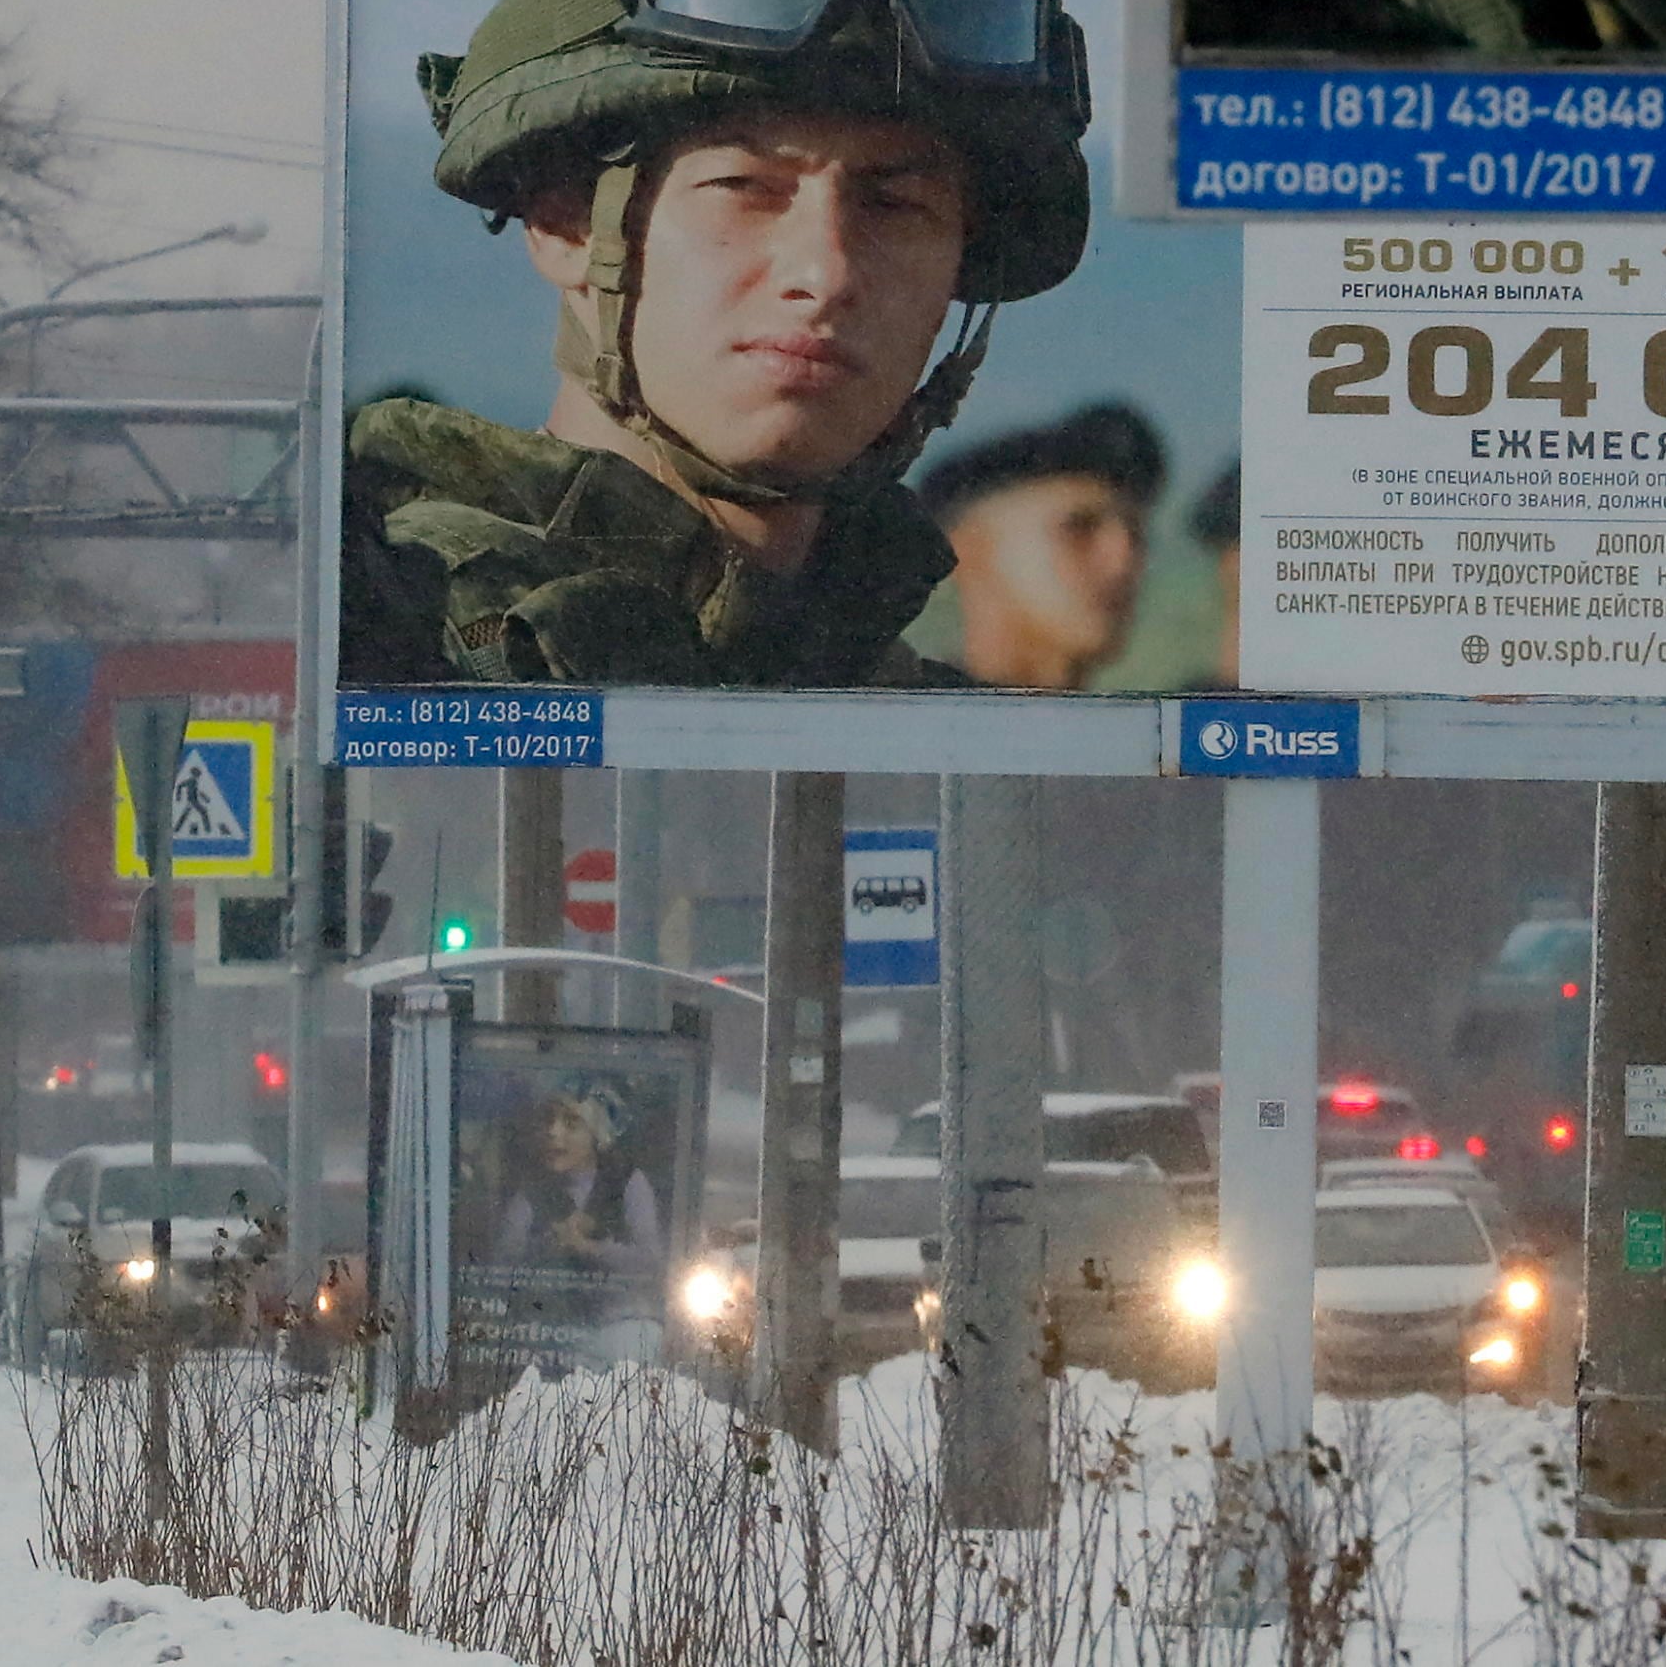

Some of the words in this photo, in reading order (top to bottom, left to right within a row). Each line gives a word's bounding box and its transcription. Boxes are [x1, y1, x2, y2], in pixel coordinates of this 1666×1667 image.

[1193, 92, 1304, 126] тел.:
[1320, 81, 1434, 131] (812)
[1446, 85, 1665, 130] 438-4848
[1192, 159, 1404, 203] договор:
[1416, 150, 1657, 198] Т-01/2017
[1343, 237, 1453, 274] 500
[1473, 238, 1585, 275] 000
[1607, 258, 1640, 286] +
[1341, 284, 1488, 301] РЕГИОНАЛЬНАЯ
[1494, 285, 1584, 302] ВЫПЛАТА
[1307, 323, 1598, 419] 204
[1352, 469, 1369, 484] (В
[1375, 470, 1418, 484] ЗОНЕ
[1425, 468, 1552, 487] СПЕЦИАЛЬНОЙ
[1559, 469, 1639, 488] ВОЕННОЙ
[1383, 492, 1405, 506] ОТ
[1411, 492, 1512, 507] ВОИНСКОГО
[1518, 491, 1592, 511] ЗВАНИЯ,
[1277, 529, 1424, 551] ВОЗМОЖНОСТЬ
[1457, 532, 1556, 553] ПОЛУЧИТЬ
[1277, 562, 1376, 582] ВЫПЛАТЫ
[1395, 563, 1434, 583] ПРИ
[1452, 562, 1639, 588] ТРУДОУСТРОЙСТВЕ
[1276, 593, 1468, 615] САНКТ-ПЕТЕРБУРГА
[1476, 596, 1487, 615] В
[1494, 595, 1581, 618] ТЕЧЕНИЕ
[345, 705, 402, 723] тел.:
[411, 699, 469, 724] (812)
[477, 701, 591, 723] 438-4848
[345, 740, 456, 763] договор:
[1245, 723, 1339, 756] Russ
